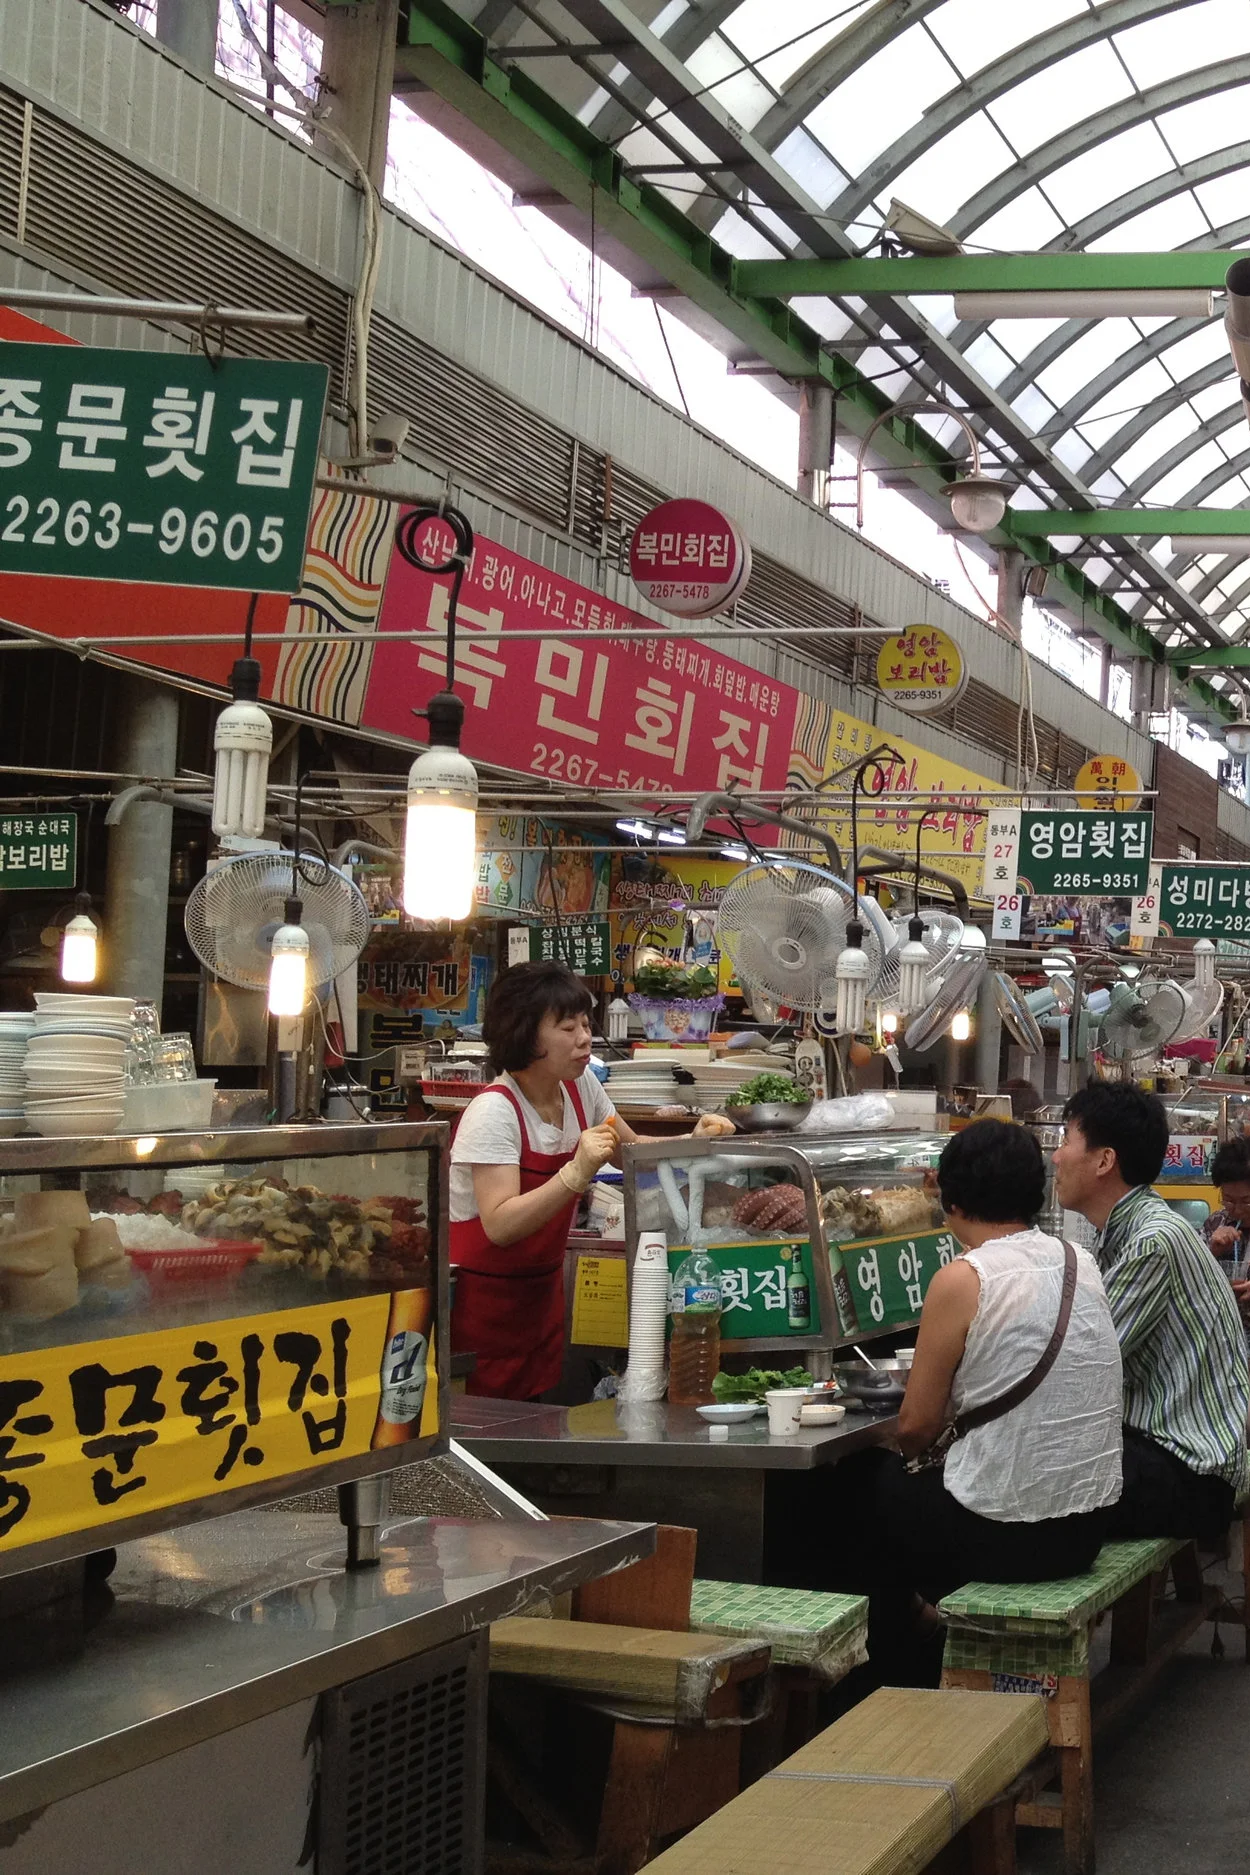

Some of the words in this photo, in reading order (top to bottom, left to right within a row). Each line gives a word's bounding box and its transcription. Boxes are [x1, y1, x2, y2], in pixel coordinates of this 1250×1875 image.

[2, 495, 285, 563] 2263-9605
[636, 532, 731, 567] 복민회집
[650, 583, 710, 600] 2267-5478
[896, 632, 943, 658] 영암
[885, 659, 952, 686] 보리밥
[410, 582, 770, 793] 복민회집
[894, 691, 942, 700] 2265-9351
[2, 820, 34, 836] 해장국
[38, 820, 70, 836] 순대국
[990, 825, 1017, 837] 동부A
[1029, 821, 1146, 859] 영암횟집
[0, 844, 69, 871] 보리밥
[993, 845, 1013, 858] 27
[993, 866, 1009, 880] 호
[1053, 873, 1138, 888] 2265-9351
[997, 895, 1019, 911] 26
[1137, 896, 1155, 909] 26
[1000, 916, 1013, 929] 호
[1138, 912, 1152, 924] 호
